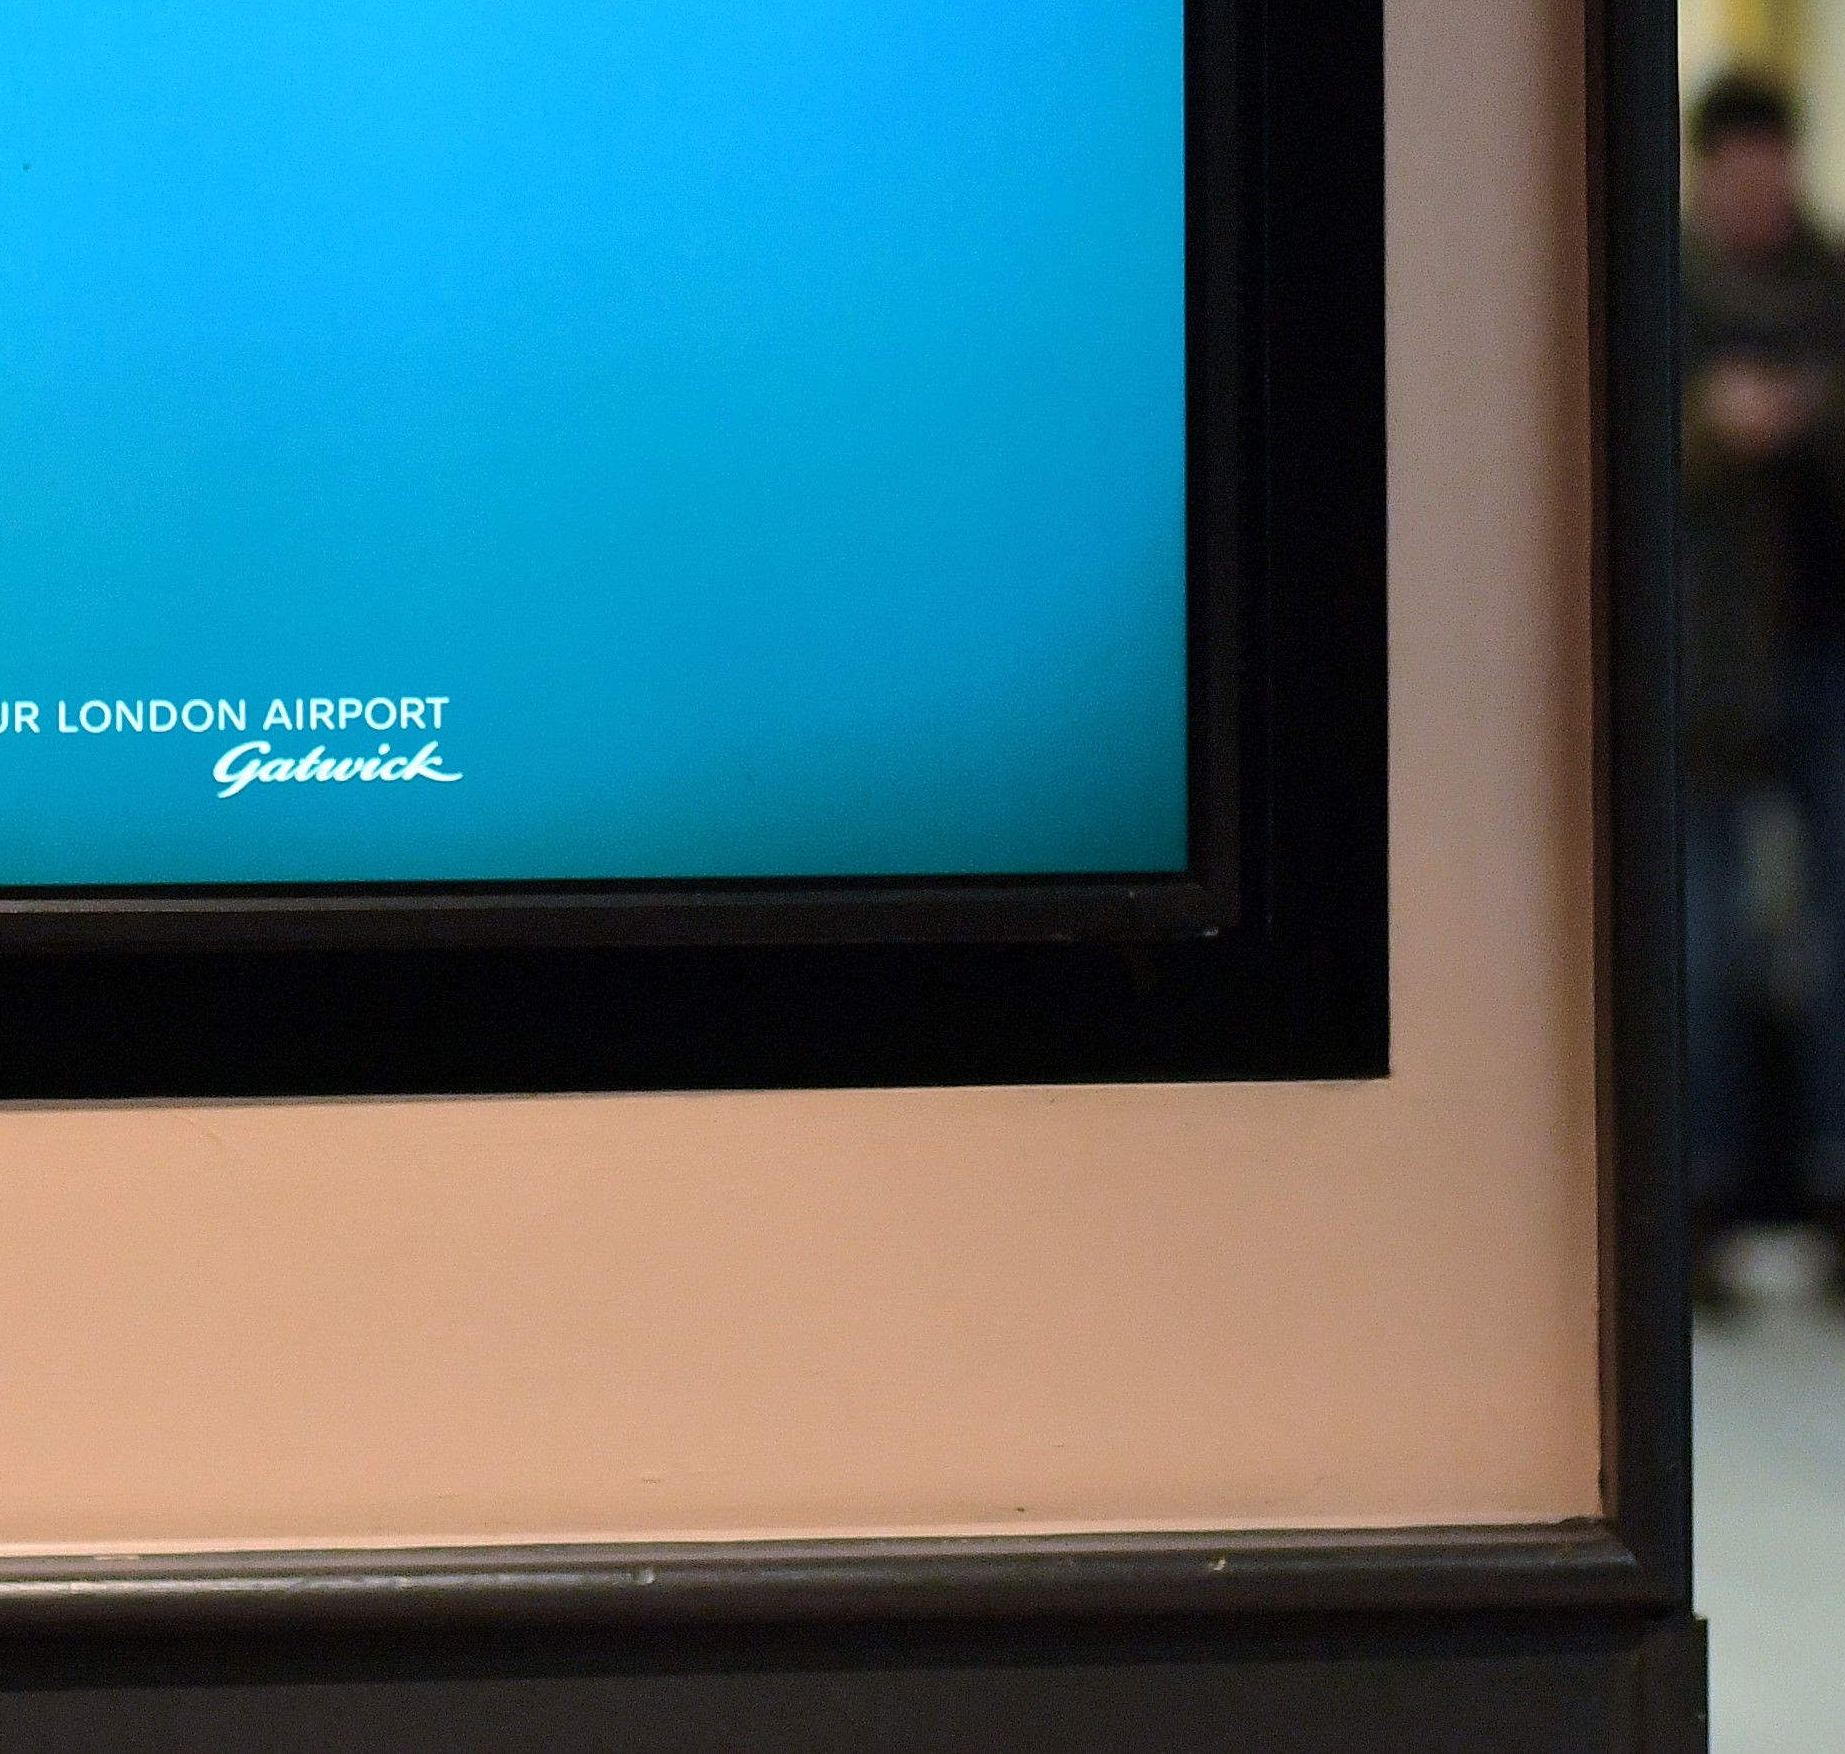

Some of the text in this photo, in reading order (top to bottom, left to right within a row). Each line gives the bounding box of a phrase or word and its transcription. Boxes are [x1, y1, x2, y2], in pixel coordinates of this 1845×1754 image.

[57, 699, 247, 734] LONDON
[262, 696, 450, 731] AIRPORT
[212, 740, 464, 799] Gatwick
